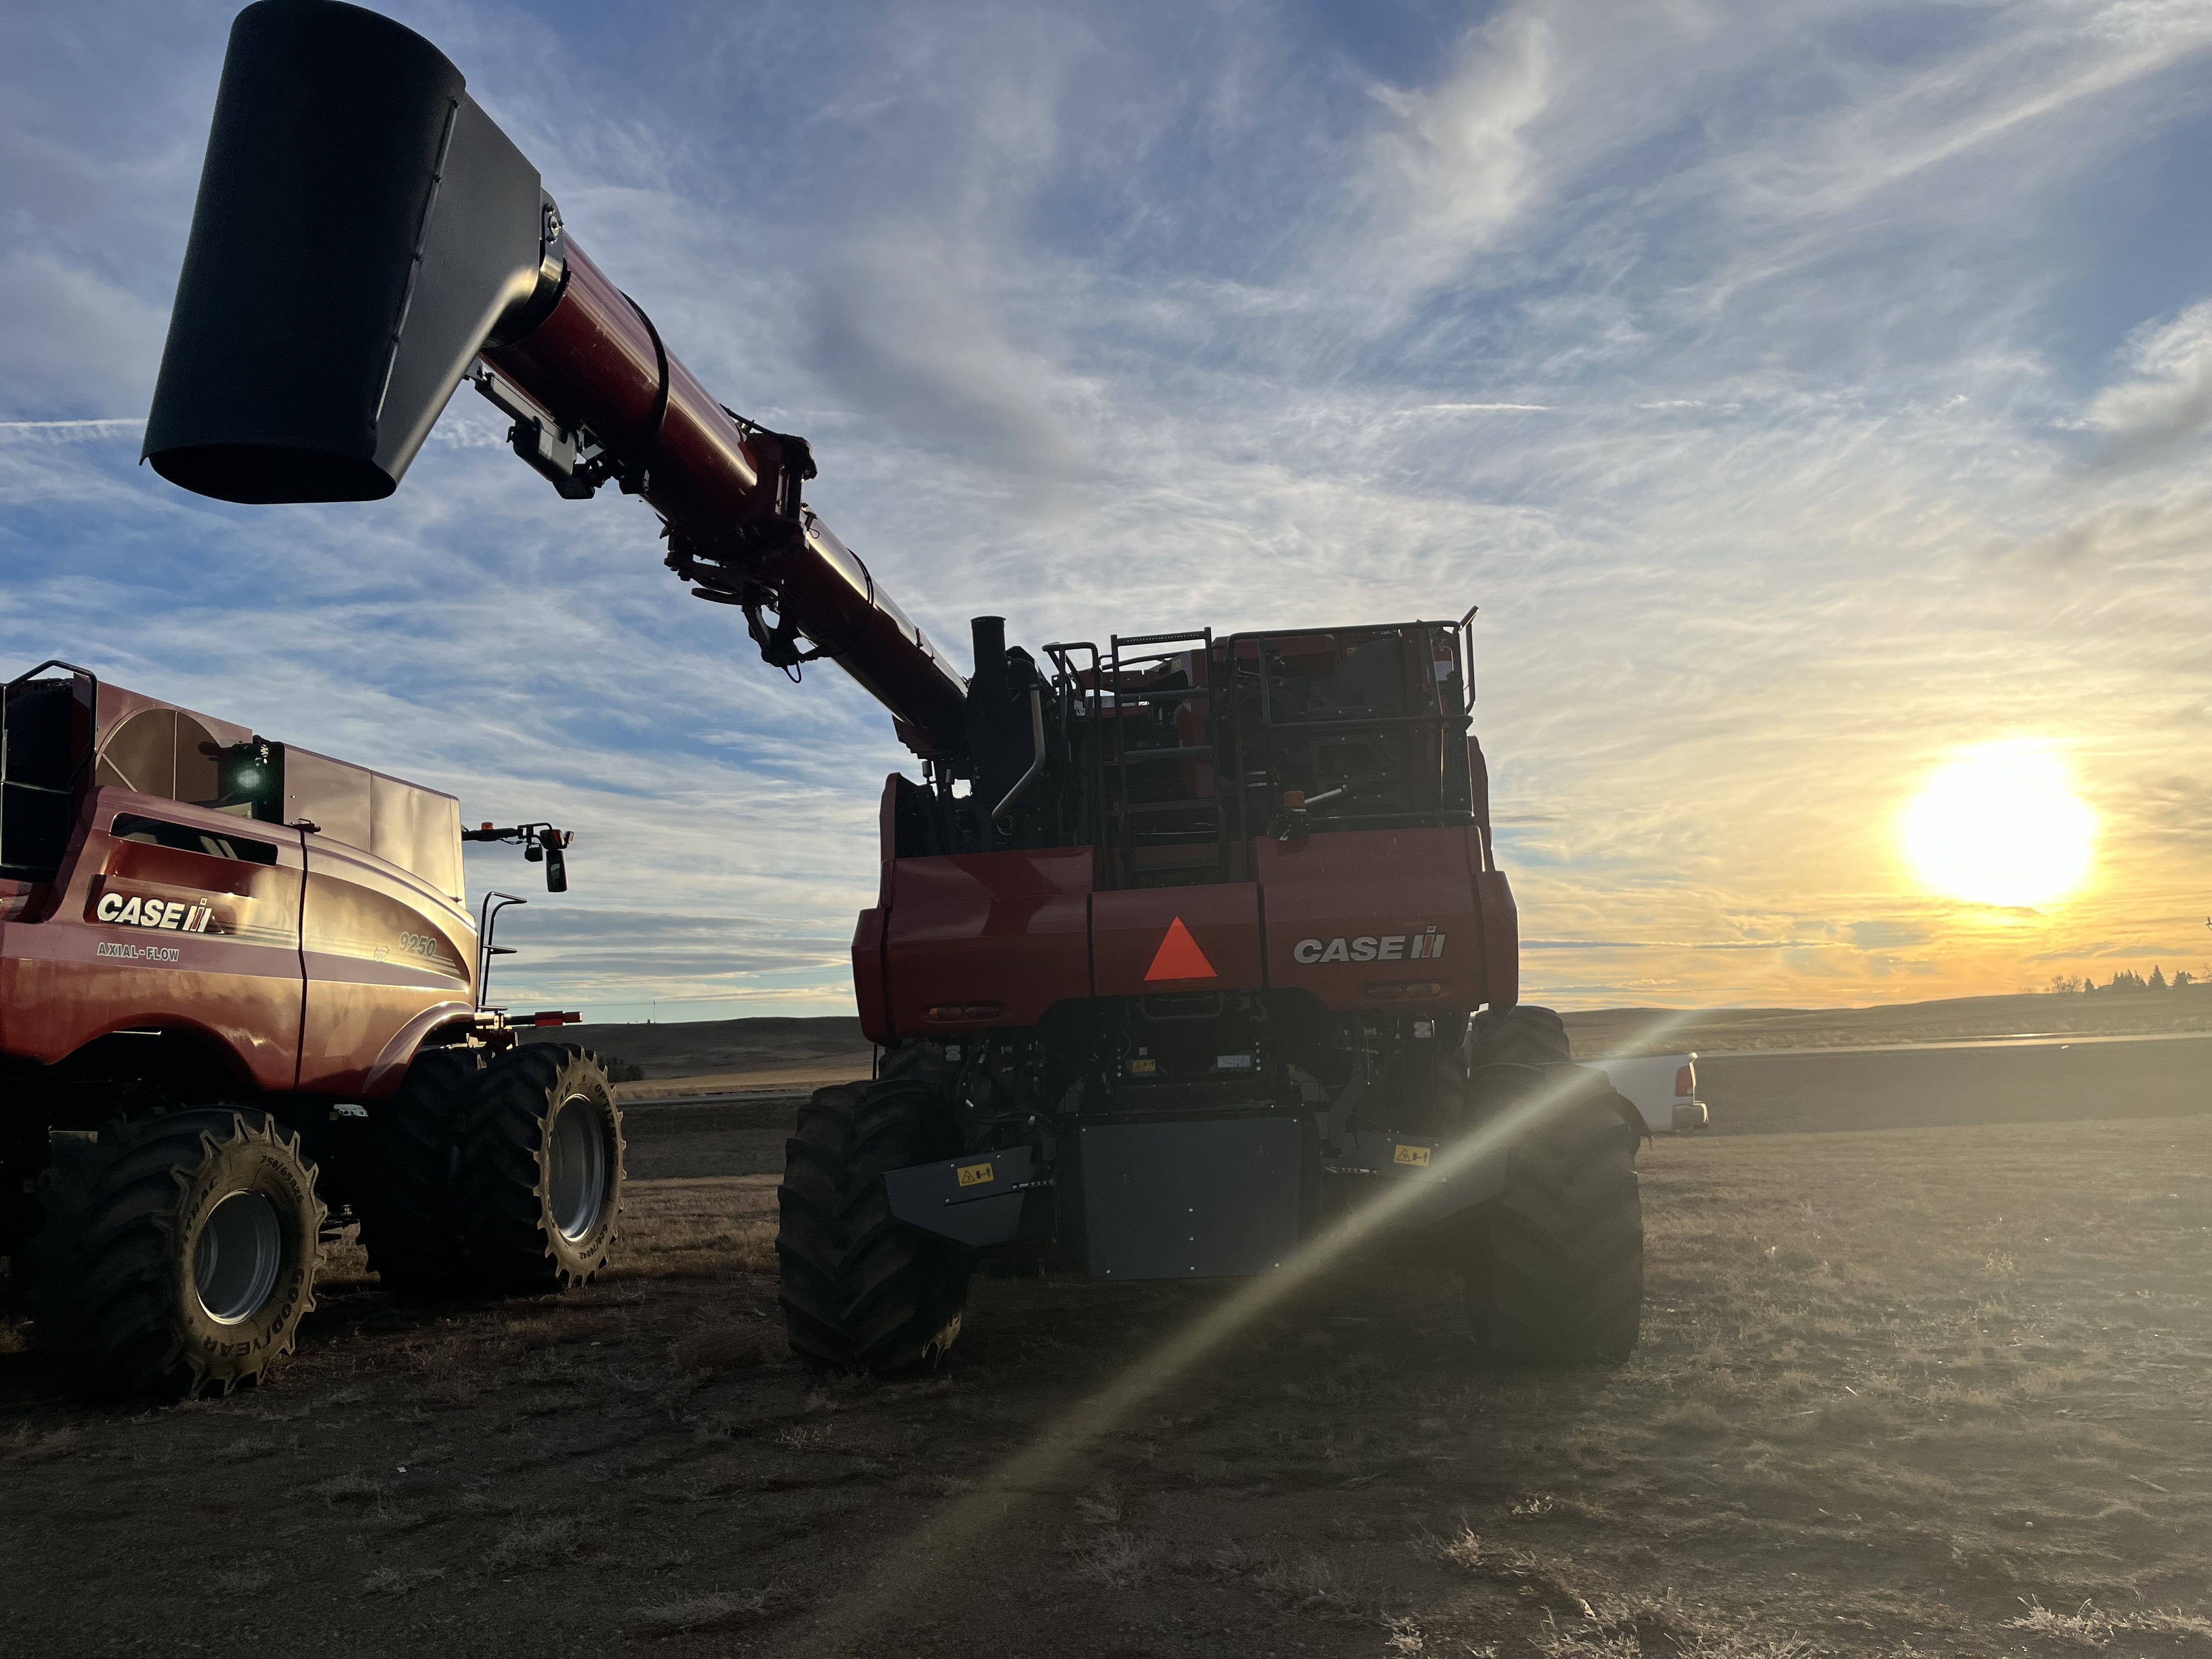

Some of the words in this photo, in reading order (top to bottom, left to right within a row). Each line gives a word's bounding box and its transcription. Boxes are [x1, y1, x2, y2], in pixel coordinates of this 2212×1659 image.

[97, 893, 185, 929] CASE
[97, 942, 179, 962] AXIAL-FLOW
[398, 932, 437, 958] 9250
[1294, 935, 1406, 964] CASE
